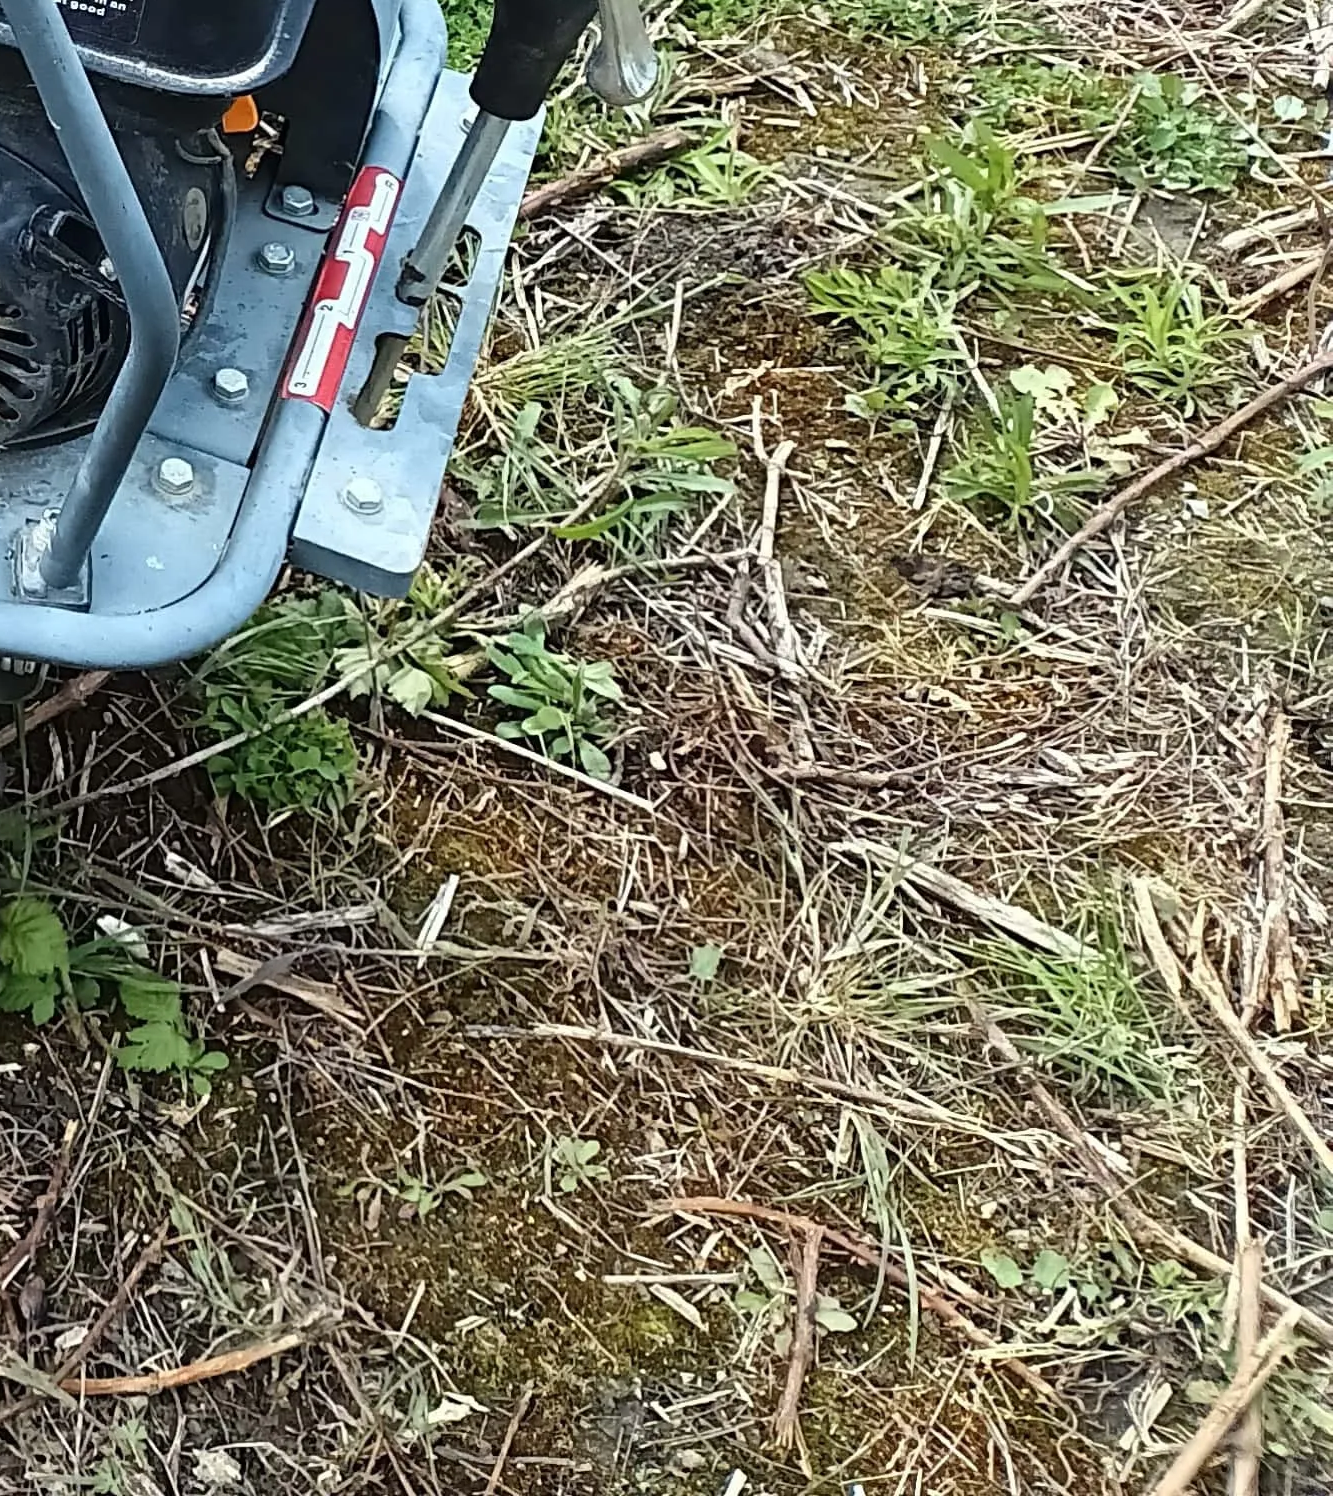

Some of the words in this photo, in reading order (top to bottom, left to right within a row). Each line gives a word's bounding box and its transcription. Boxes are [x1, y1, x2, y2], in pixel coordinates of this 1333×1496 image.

[69, 0, 106, 17] good
[109, 0, 127, 11] an
[319, 304, 334, 312] 2
[293, 381, 308, 389] 3
